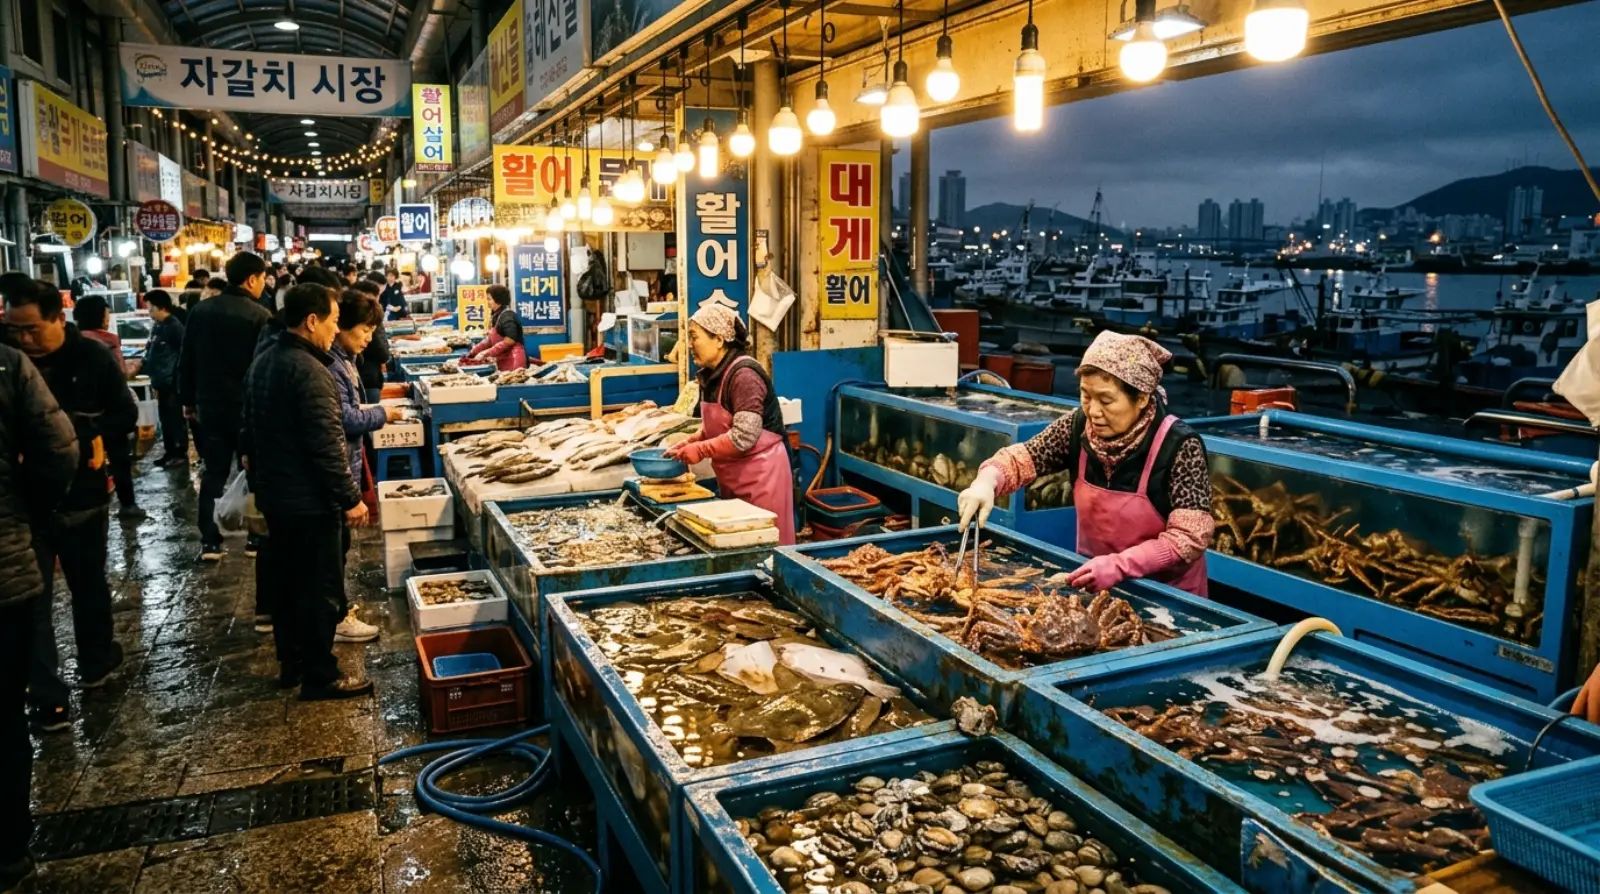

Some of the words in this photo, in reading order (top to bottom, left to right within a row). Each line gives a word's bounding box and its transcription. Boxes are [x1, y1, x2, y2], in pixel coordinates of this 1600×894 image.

[180, 56, 296, 101] 자갈치
[312, 63, 387, 104] 시장
[502, 153, 572, 197] 활어
[829, 162, 872, 262] 대게
[521, 276, 558, 297] 대게
[825, 274, 870, 304] 활어
